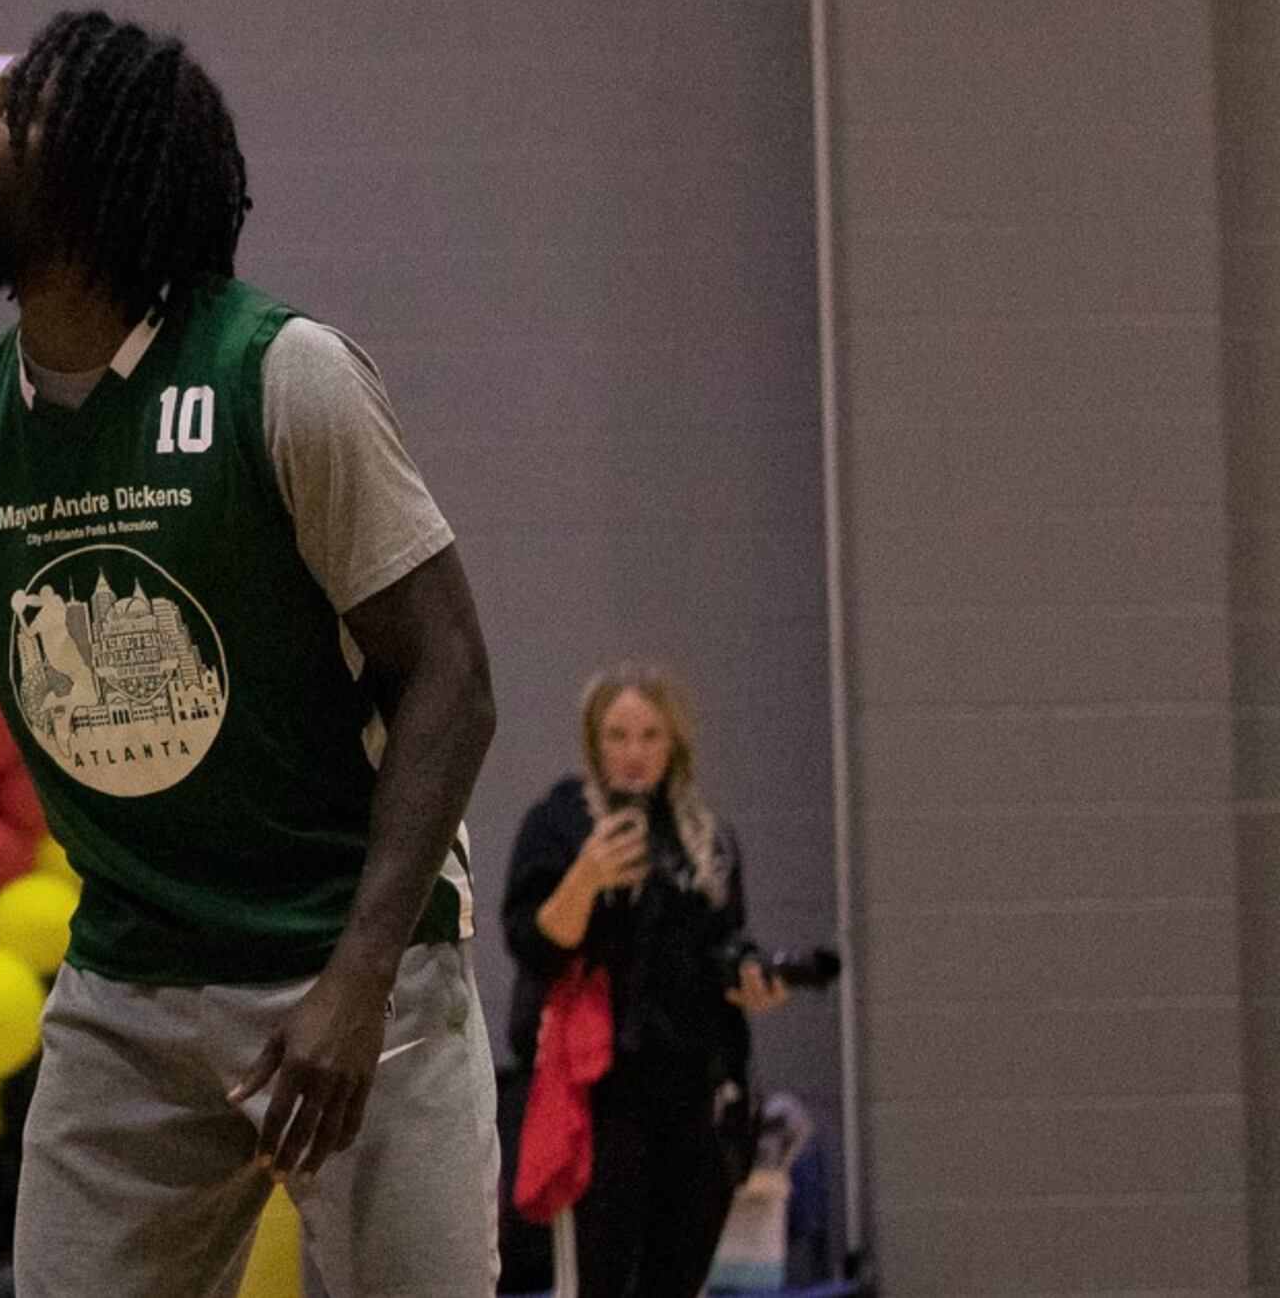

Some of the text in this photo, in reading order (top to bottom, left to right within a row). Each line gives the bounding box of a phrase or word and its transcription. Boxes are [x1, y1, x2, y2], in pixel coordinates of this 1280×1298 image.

[156, 385, 215, 454] 10
[52, 491, 109, 519] Andre
[114, 485, 192, 511] Dickens
[75, 740, 190, 767] ATLANTA
